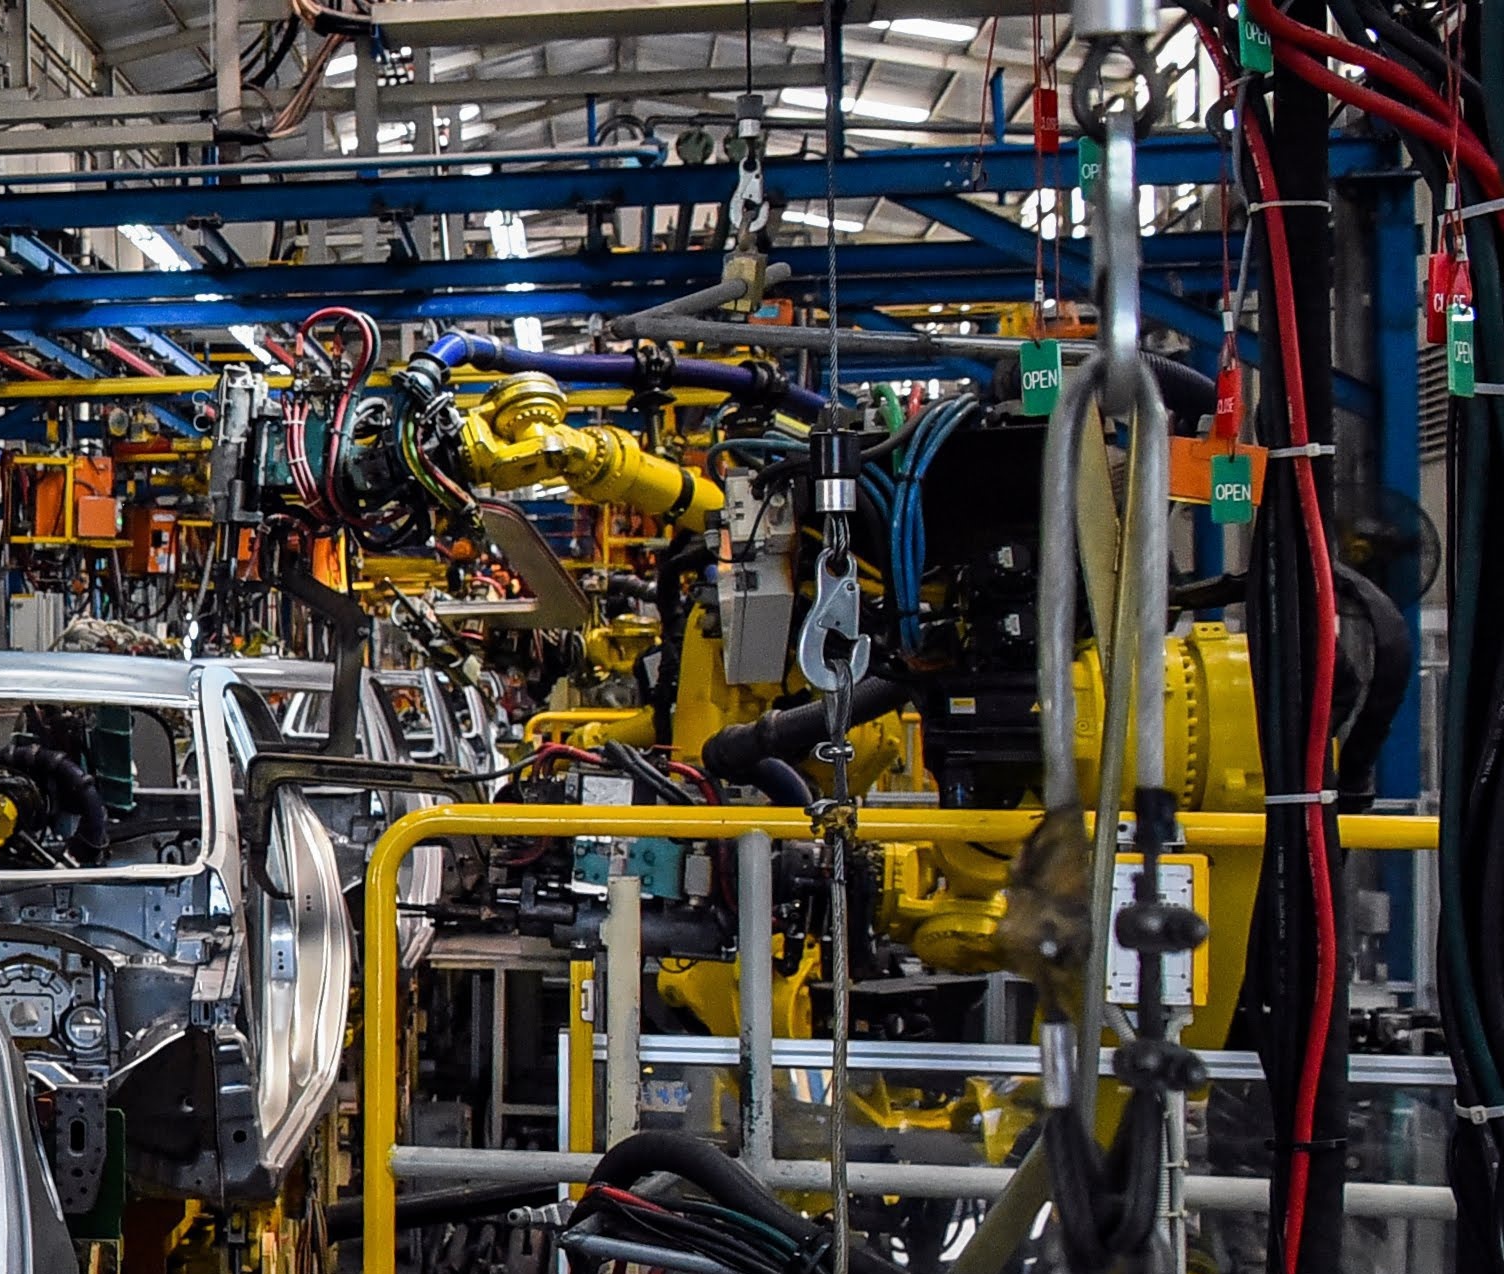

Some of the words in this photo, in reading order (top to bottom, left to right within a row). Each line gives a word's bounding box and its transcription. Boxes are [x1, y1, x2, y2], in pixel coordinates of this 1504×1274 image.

[1245, 21, 1271, 47] OPEN
[1454, 341, 1473, 364] OPEN
[1022, 369, 1058, 390] OPEN
[1217, 396, 1234, 415] CLOSE
[1215, 483, 1252, 501] OPEN
